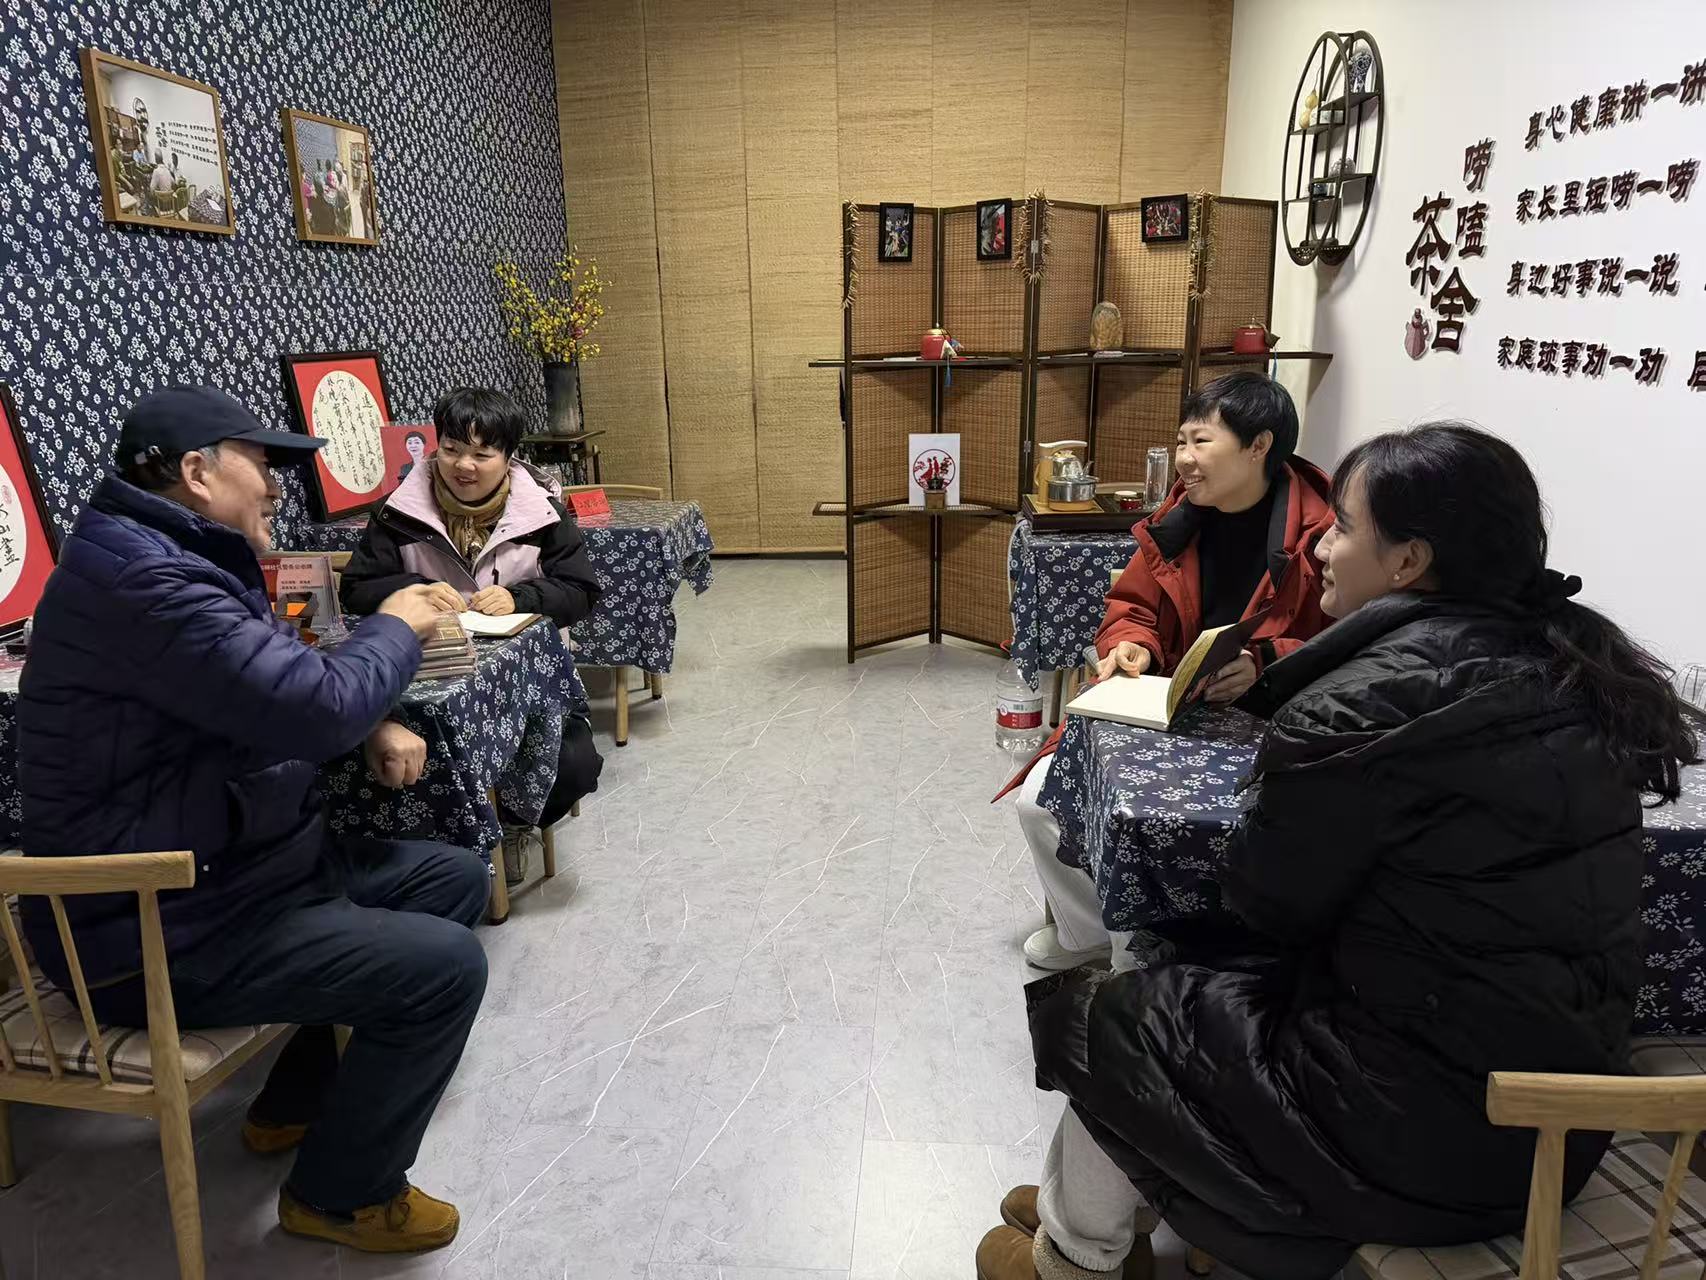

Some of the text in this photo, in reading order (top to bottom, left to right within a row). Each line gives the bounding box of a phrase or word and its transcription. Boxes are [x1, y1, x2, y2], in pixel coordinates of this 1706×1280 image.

[1524, 59, 1706, 150] 身心健康讲一讲
[1517, 158, 1698, 222] 家长里短唠一唠
[1507, 253, 1678, 296] 身边好事说一说
[1497, 336, 1665, 383] 家庭琐事劝一劝
